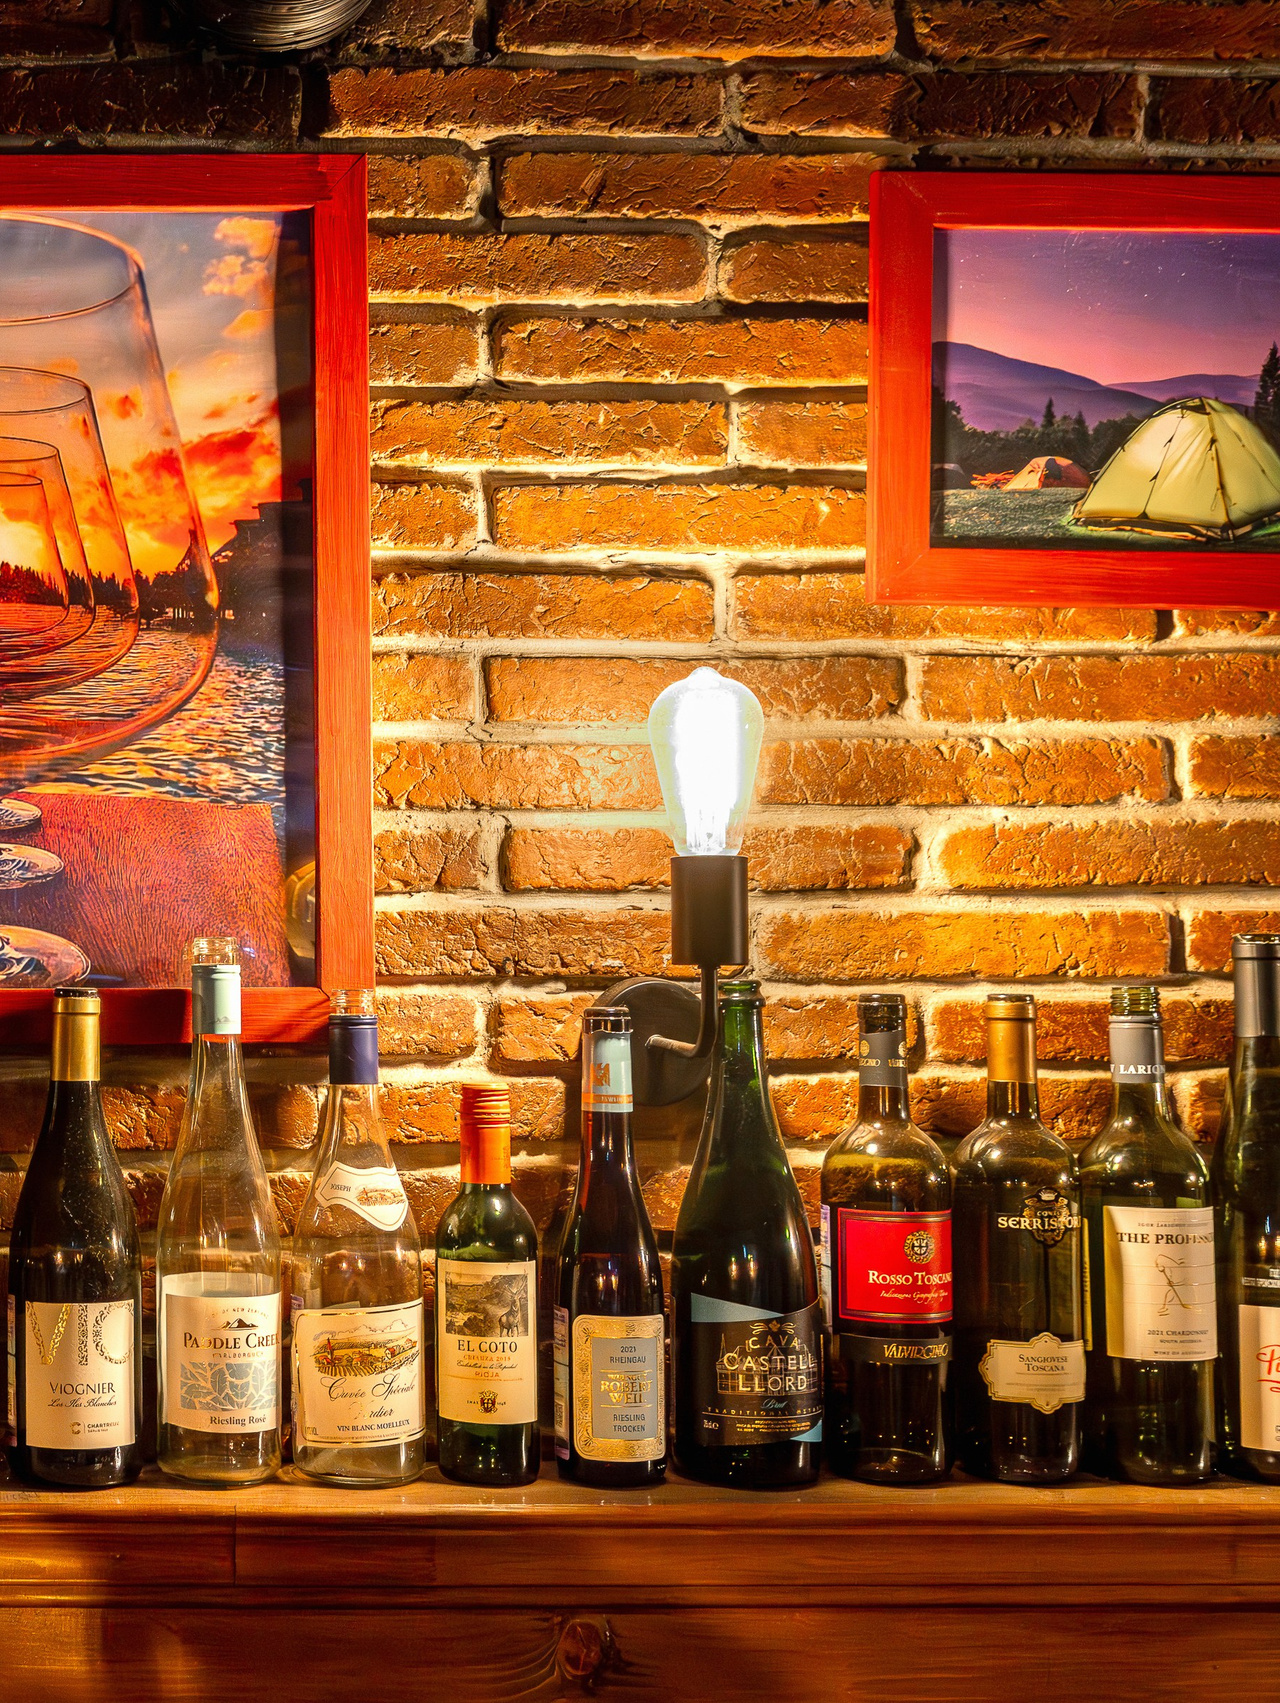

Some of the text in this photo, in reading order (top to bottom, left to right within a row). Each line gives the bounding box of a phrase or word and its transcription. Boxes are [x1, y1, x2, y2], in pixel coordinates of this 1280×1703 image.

[1116, 1232, 1150, 1244] THE
[867, 1269, 953, 1286] ROSSO TOSCAN
[183, 1331, 241, 1350] PADDLE
[457, 1339, 518, 1353] EL COTO
[749, 1334, 799, 1349] CAVA
[620, 1345, 637, 1353] 2021
[463, 1354, 494, 1362] CRIANZA
[609, 1355, 647, 1364] RHEINGAU
[723, 1352, 816, 1371] CASTELL
[1018, 1353, 1068, 1364] SANGIOVESE
[1024, 1363, 1065, 1372] TOSCANA
[49, 1381, 116, 1395] VIOGNIER
[320, 1373, 417, 1401] Cuvée Spéciale
[600, 1380, 653, 1393] ROBERT
[738, 1374, 808, 1392] LLORD
[47, 1397, 64, 1408] Les
[83, 1395, 117, 1408] Blanches
[760, 1398, 788, 1410] Brut
[210, 1414, 267, 1427] Riesling Rosé
[613, 1413, 646, 1422] RIESLING
[336, 1418, 411, 1432] VIN BLANC MOELLEUX
[613, 1424, 646, 1433] TROCKEN
